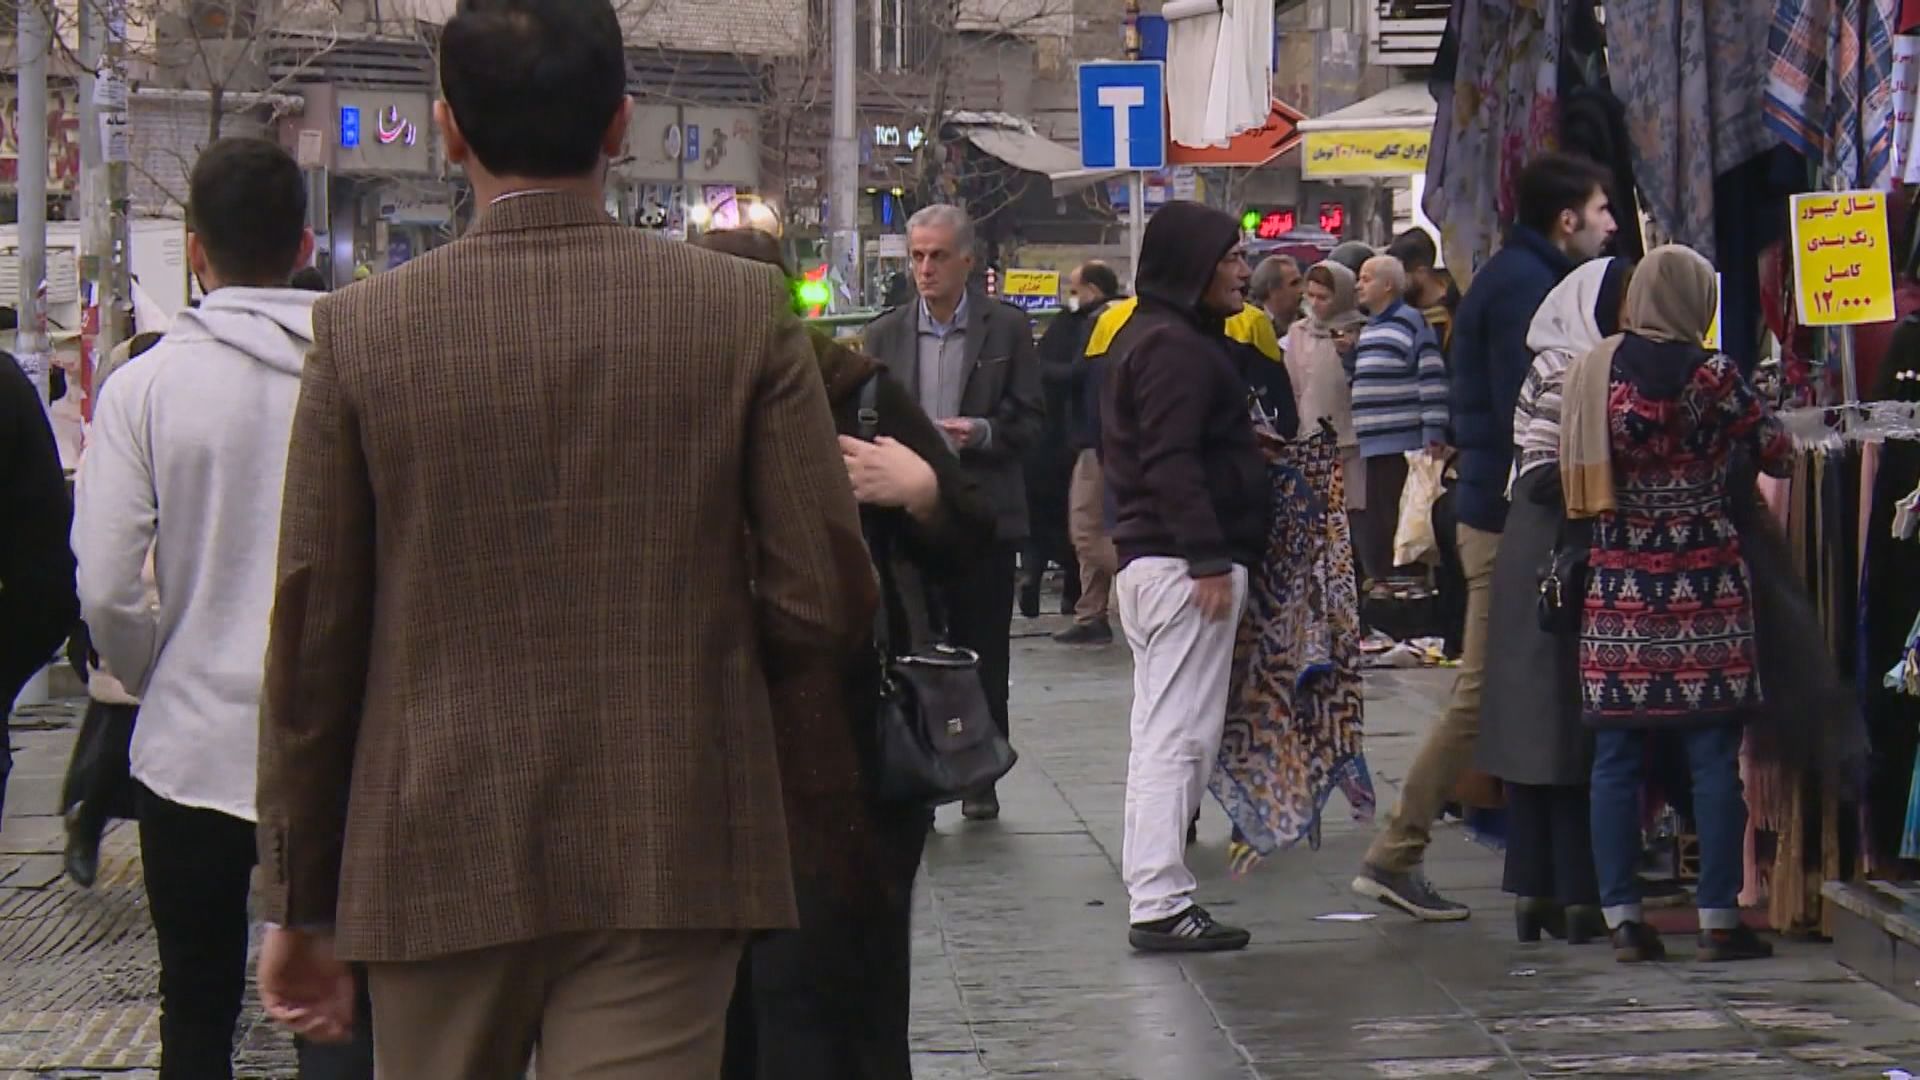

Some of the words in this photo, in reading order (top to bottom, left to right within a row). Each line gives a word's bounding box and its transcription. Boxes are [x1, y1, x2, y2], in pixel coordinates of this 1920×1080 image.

[1843, 196, 1876, 216] شال
[1807, 233, 1846, 252] بندی
[1849, 229, 1875, 248] رنگ
[1823, 263, 1862, 284] کامل
